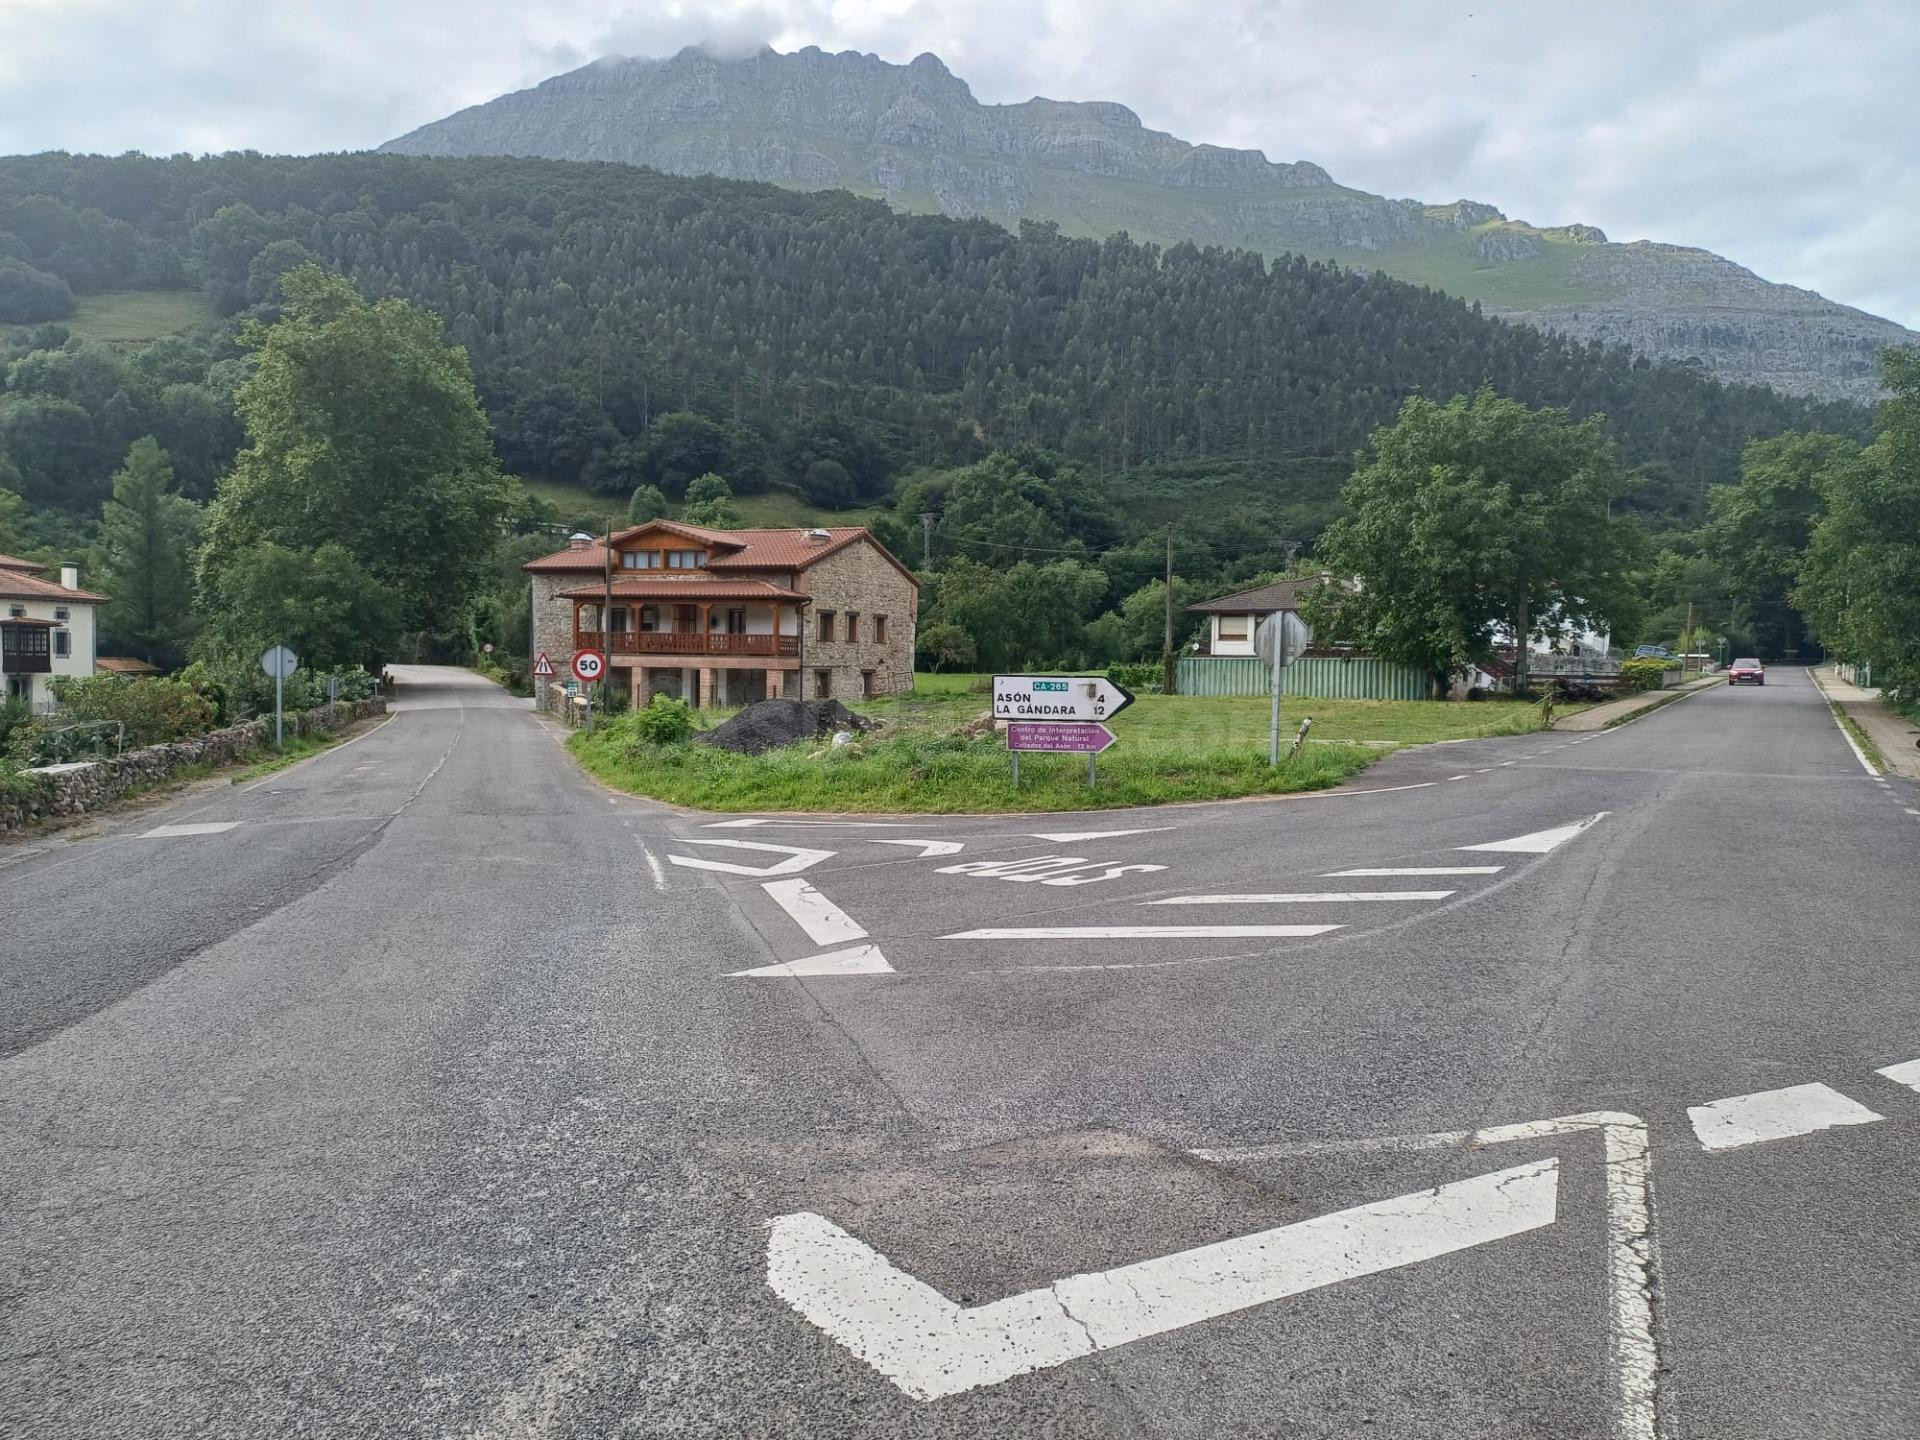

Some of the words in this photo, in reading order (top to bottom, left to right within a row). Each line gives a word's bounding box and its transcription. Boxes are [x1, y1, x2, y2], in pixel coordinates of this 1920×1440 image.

[580, 660, 598, 671] 50
[1033, 682, 1068, 691] CA-265
[997, 692, 1031, 703] ASÓN
[1097, 694, 1105, 703] 4
[996, 705, 1010, 714] LA
[1017, 703, 1076, 715] GÁNDARA
[1094, 706, 1105, 715] 12
